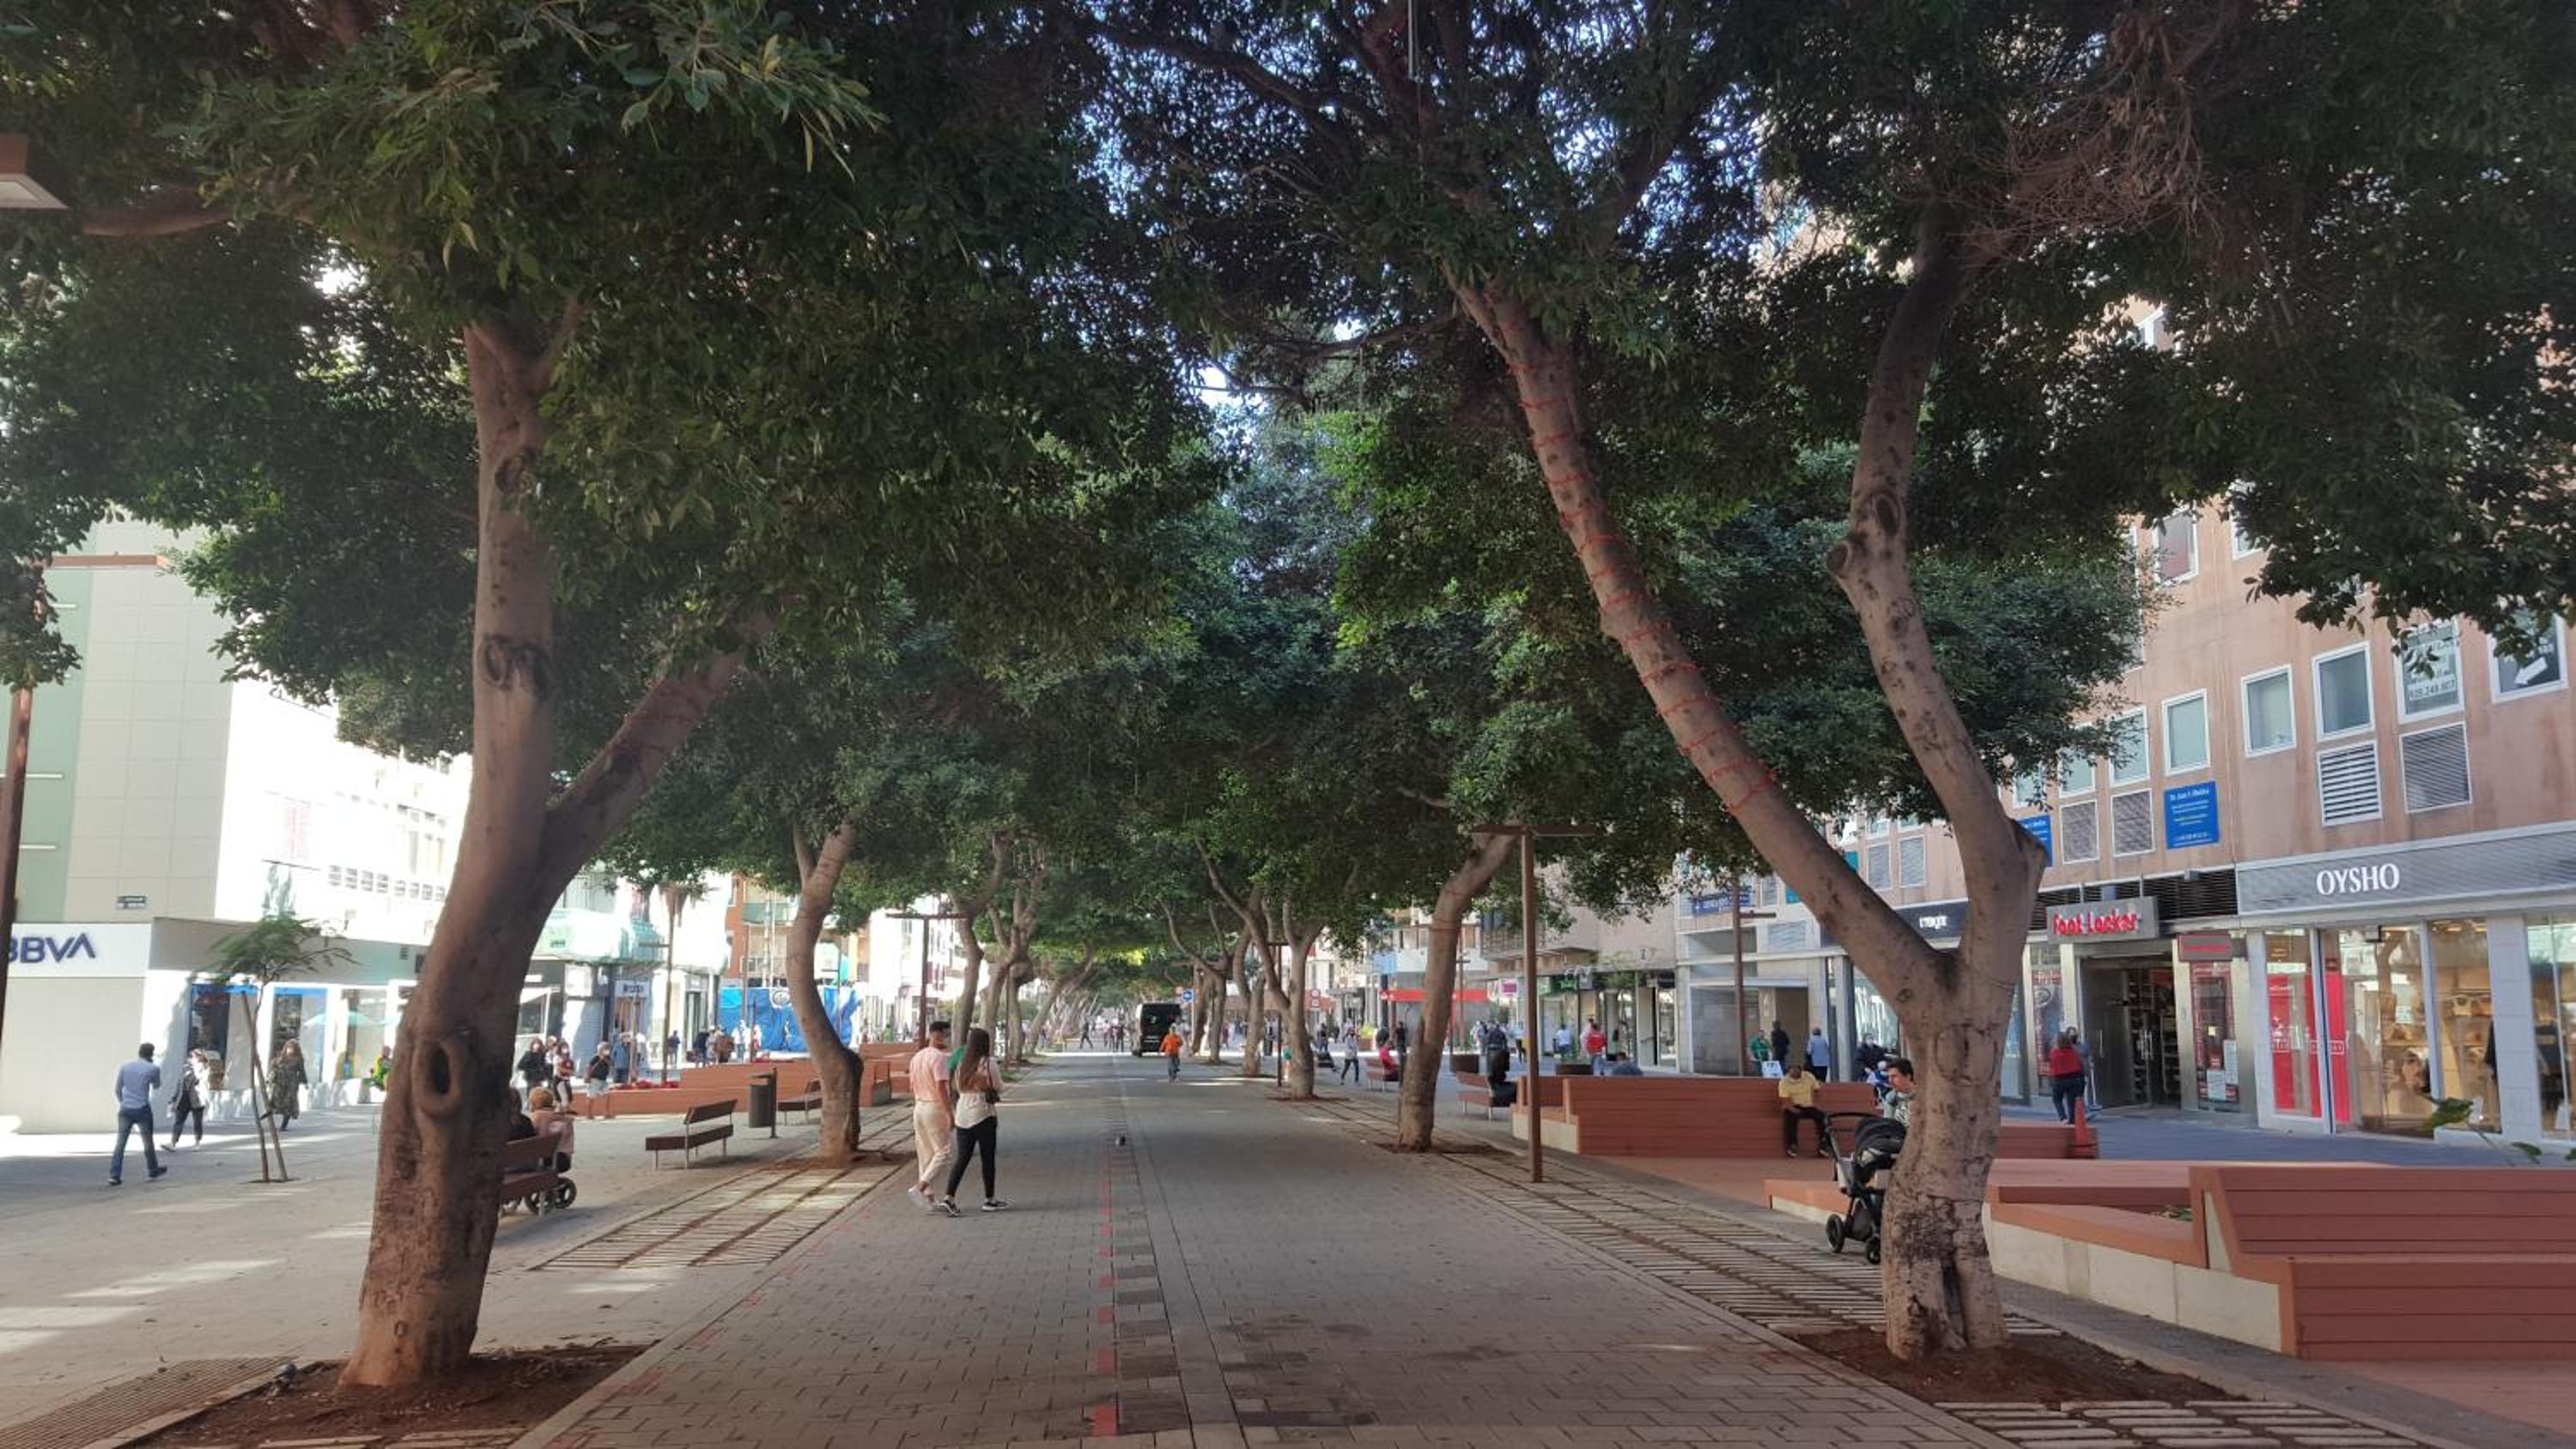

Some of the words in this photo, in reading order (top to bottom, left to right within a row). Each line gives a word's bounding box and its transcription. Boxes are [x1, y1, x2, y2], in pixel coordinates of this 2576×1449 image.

[2316, 863, 2400, 895] OYSHO
[2053, 913, 2082, 935] Foot
[2087, 909, 2138, 933] Locker
